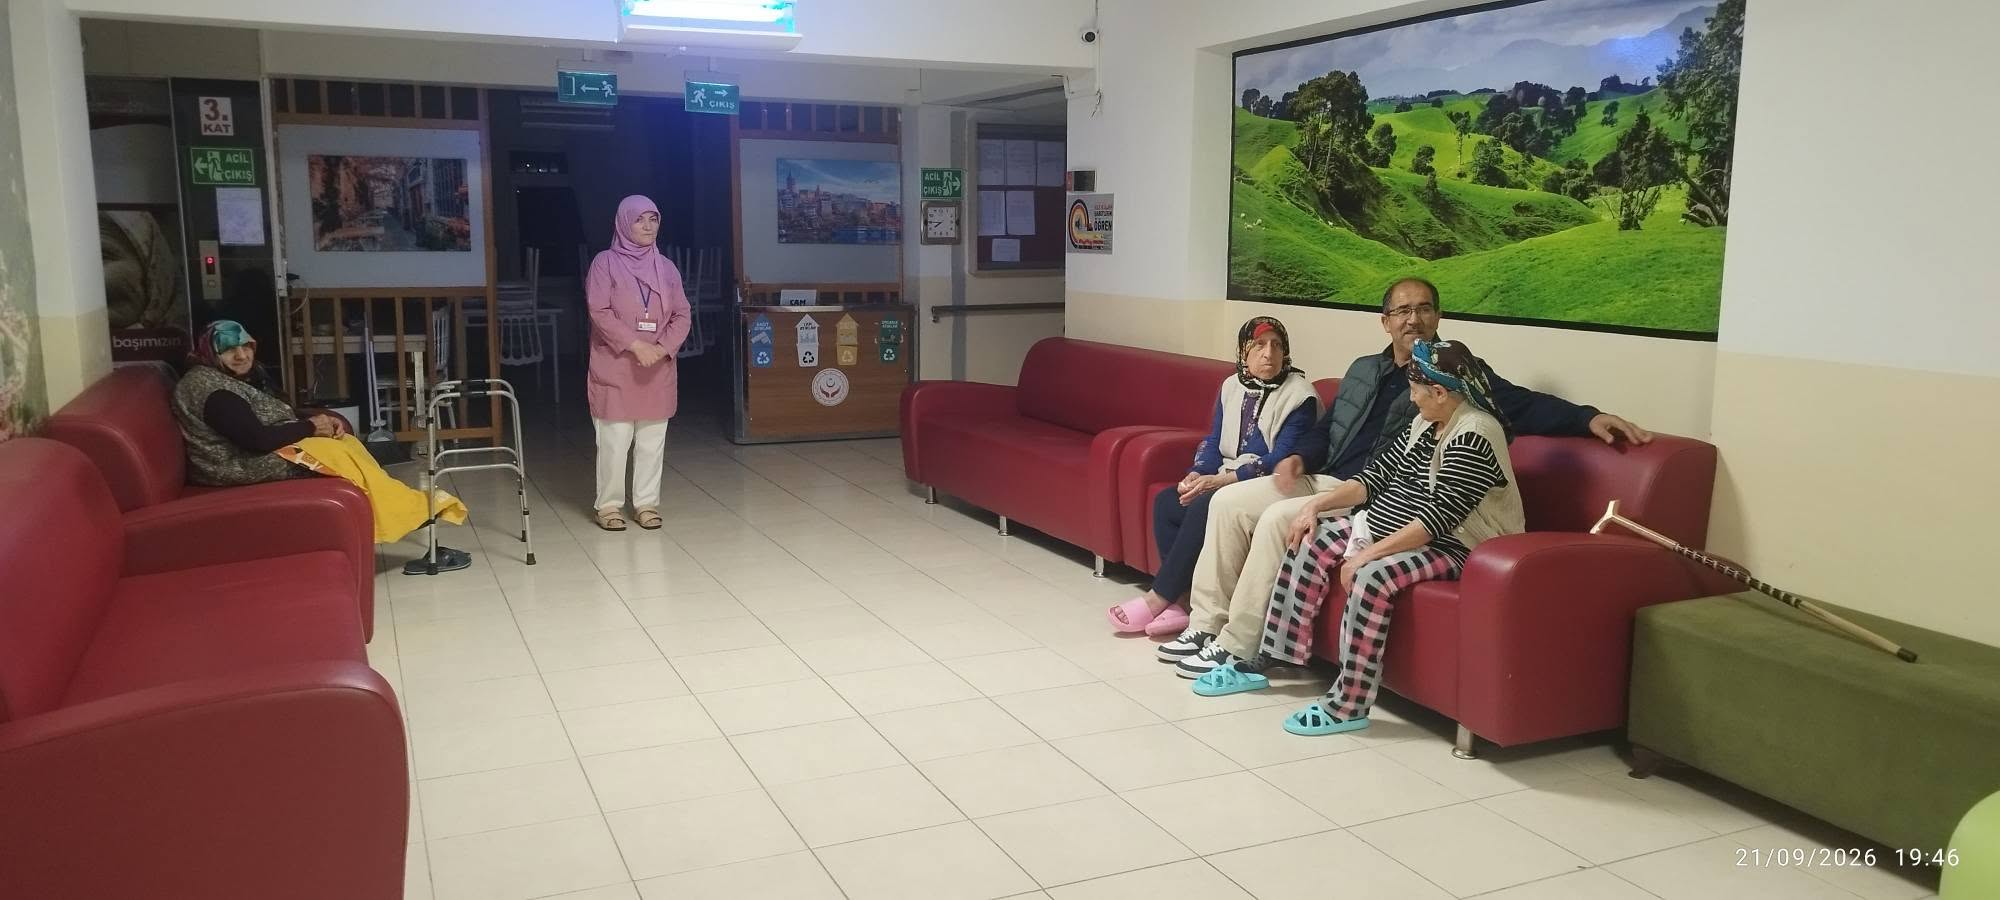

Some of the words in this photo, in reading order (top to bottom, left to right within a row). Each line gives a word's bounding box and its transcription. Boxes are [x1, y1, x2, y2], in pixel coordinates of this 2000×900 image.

[203, 98, 228, 121] 3.
[203, 124, 231, 133] KAT
[225, 151, 249, 164] ACİL
[224, 170, 252, 182] ÇIKIŞ
[924, 171, 941, 181] ACİL
[923, 186, 942, 196] ÇIKIŞ
[112, 335, 181, 351] başımızın
